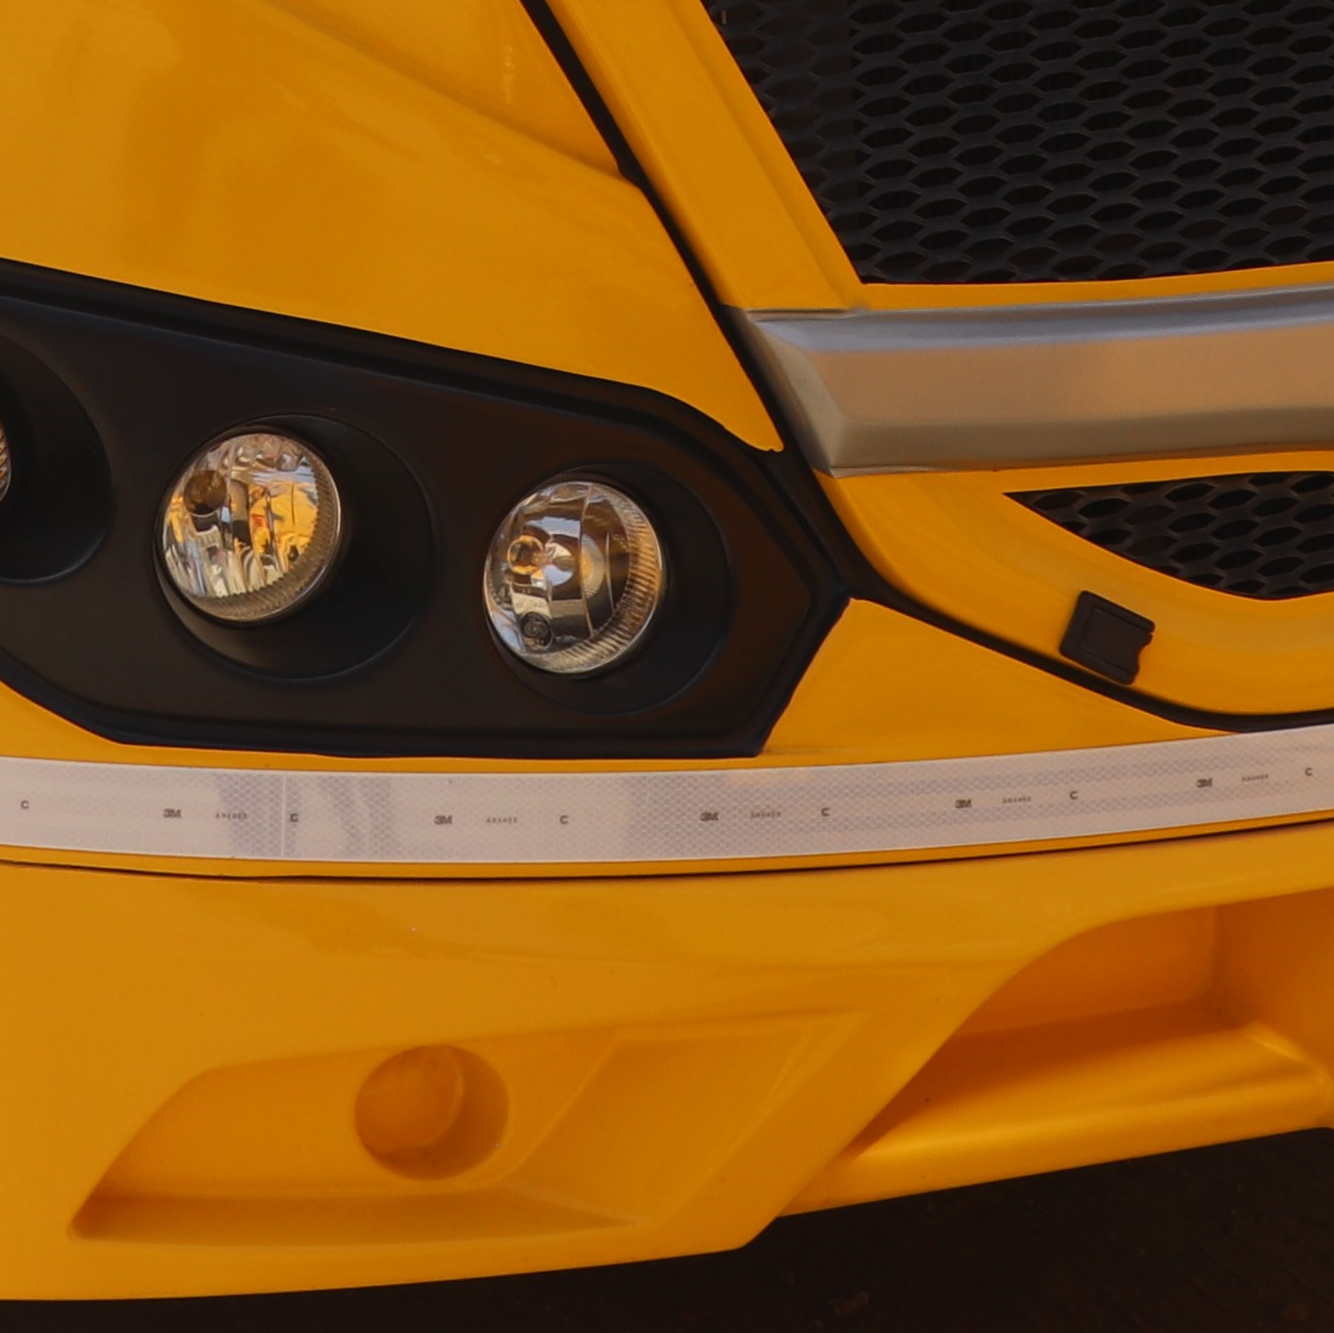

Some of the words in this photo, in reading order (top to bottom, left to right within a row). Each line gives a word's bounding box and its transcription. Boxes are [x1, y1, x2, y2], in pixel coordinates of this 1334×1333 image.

[20, 799, 30, 810] C
[289, 812, 299, 823] C
[433, 814, 453, 825] 3M
[559, 814, 569, 825] C
[820, 807, 830, 817] C
[1069, 790, 1078, 800] C
[1304, 766, 1313, 776] C
